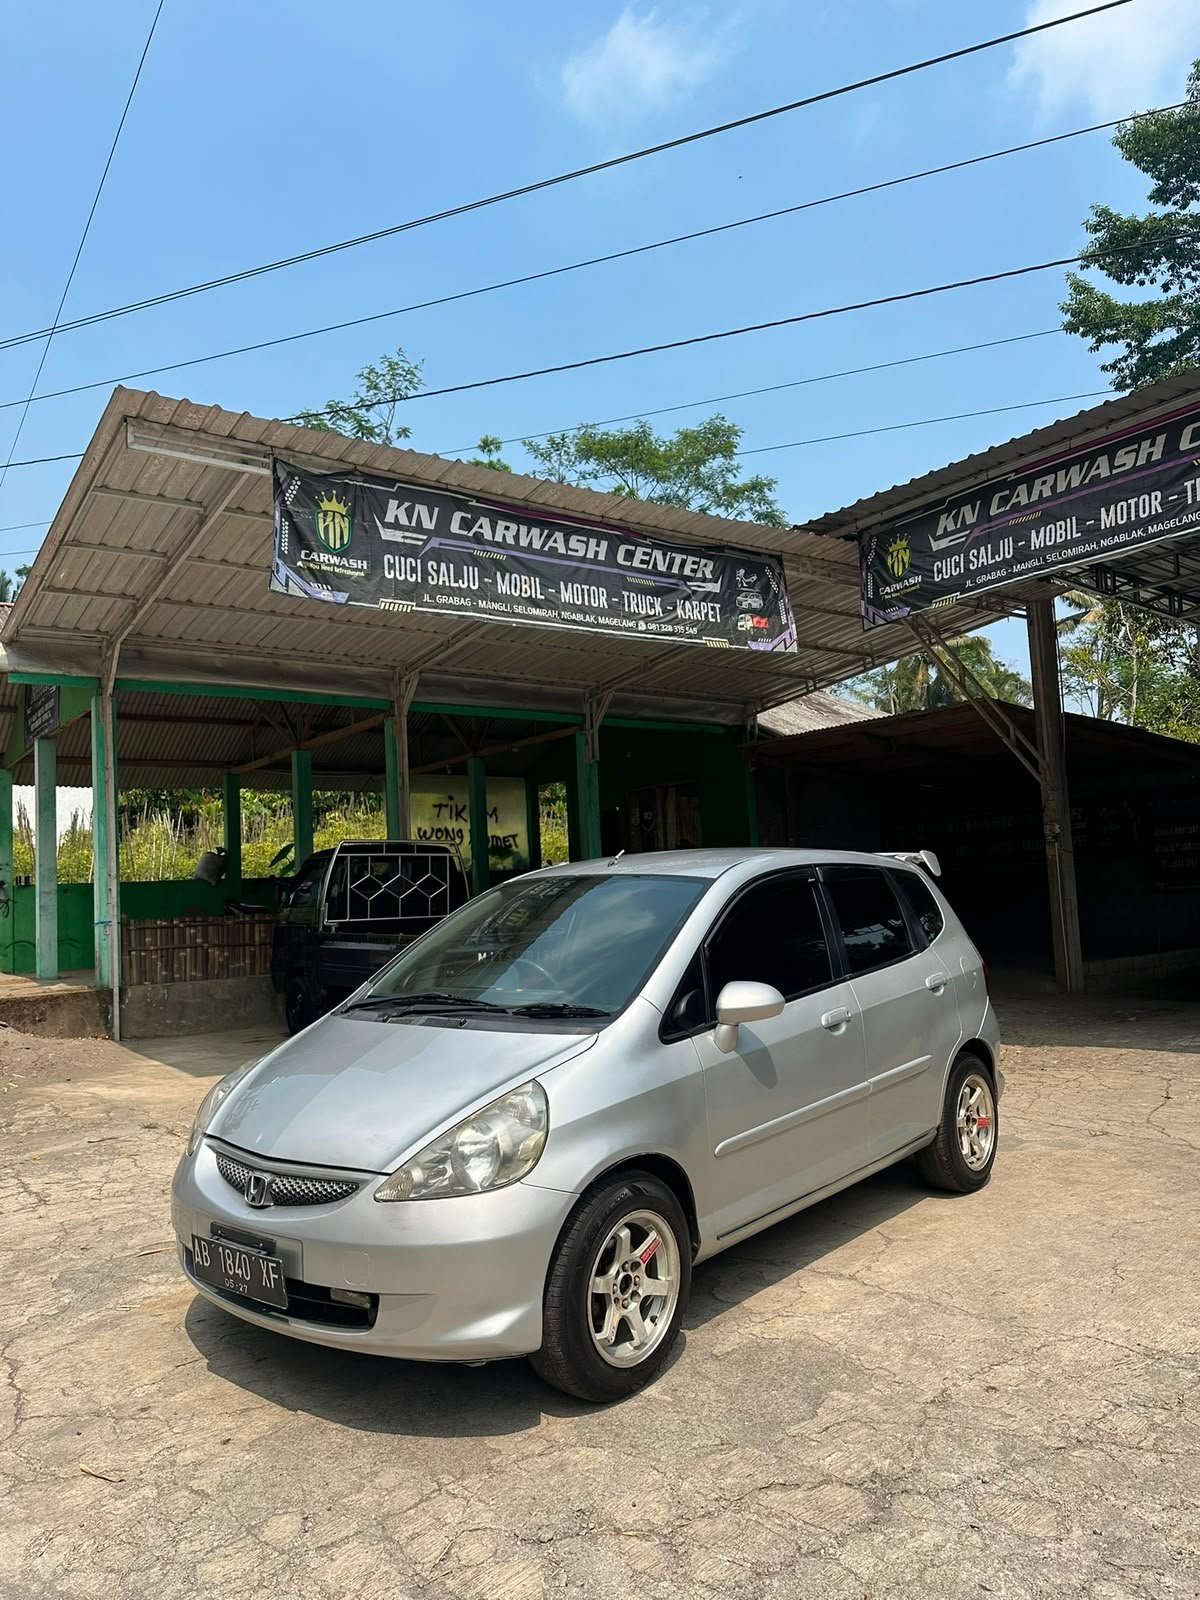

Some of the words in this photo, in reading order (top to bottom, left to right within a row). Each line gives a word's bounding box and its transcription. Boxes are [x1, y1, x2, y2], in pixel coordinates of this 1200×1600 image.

[936, 500, 982, 536] KN
[988, 433, 1168, 516] CARWASH
[300, 550, 367, 569] CARWASH
[384, 499, 440, 530] KN
[450, 511, 608, 560] CARWASH
[616, 545, 714, 579] CENTER
[933, 551, 964, 582] CUCI
[969, 536, 1013, 570] SALJU
[1030, 516, 1081, 550] MOBIL
[1100, 490, 1162, 530] MOTOR
[976, 568, 1007, 584] GRABAG
[1012, 560, 1045, 573] MANGLI,
[1046, 541, 1099, 563] SELOMIRAH,
[1100, 529, 1147, 548] NGABLAK,
[384, 554, 422, 583] CUCI
[428, 560, 479, 590] SALJU
[497, 572, 545, 599] MOBIL
[560, 581, 608, 609] MOTOR
[622, 591, 664, 617] TRUCK
[677, 599, 721, 622] KARPET
[423, 593, 434, 603] JL.
[436, 594, 472, 607] GRABAG
[478, 600, 512, 613] MANGLI,
[513, 605, 560, 619] SELOMIRAH,
[561, 612, 597, 624] NGABLAK,
[598, 616, 636, 628] MAGELANG
[879, 575, 922, 595] CARWASH
[194, 1238, 211, 1267] AB
[219, 1247, 251, 1281] 1840
[260, 1259, 279, 1288] XF
